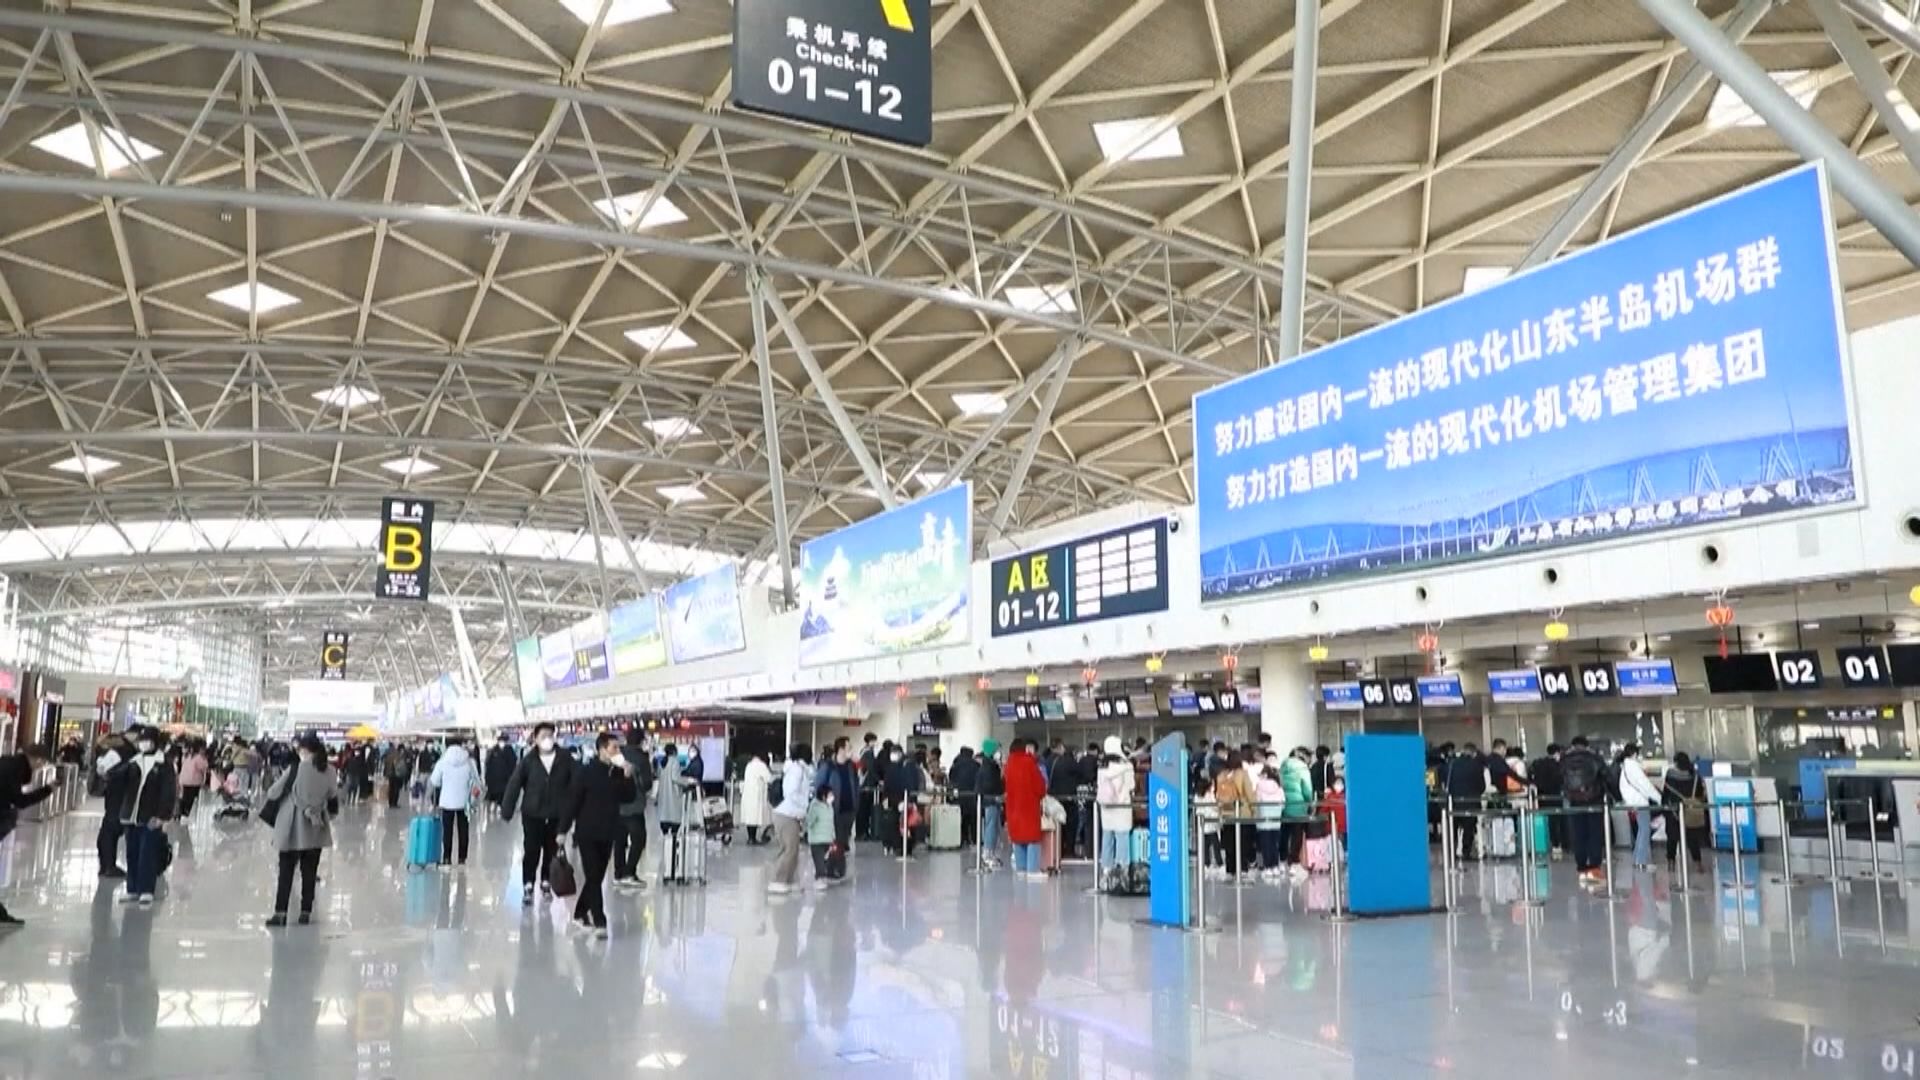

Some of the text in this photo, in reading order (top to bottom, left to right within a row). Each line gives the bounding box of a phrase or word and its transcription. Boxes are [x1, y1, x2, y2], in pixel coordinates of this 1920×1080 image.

[795, 42, 879, 77] Check-in
[768, 58, 903, 121] 01-12
[1214, 235, 1782, 457] 努力建设国内一流的现代化山东半岛机场群
[1226, 329, 1767, 510] 努力打造国内一流的现代化机场管理集团
[385, 525, 423, 571] B
[998, 591, 1060, 629] 01-12
[324, 645, 345, 667] C
[1845, 656, 1880, 681] 01
[1544, 672, 1569, 694] 04
[1583, 669, 1609, 692] 03
[1782, 659, 1816, 684] 02
[1221, 693, 1235, 709] 07
[1364, 684, 1384, 703] 06
[1393, 684, 1413, 703] 05
